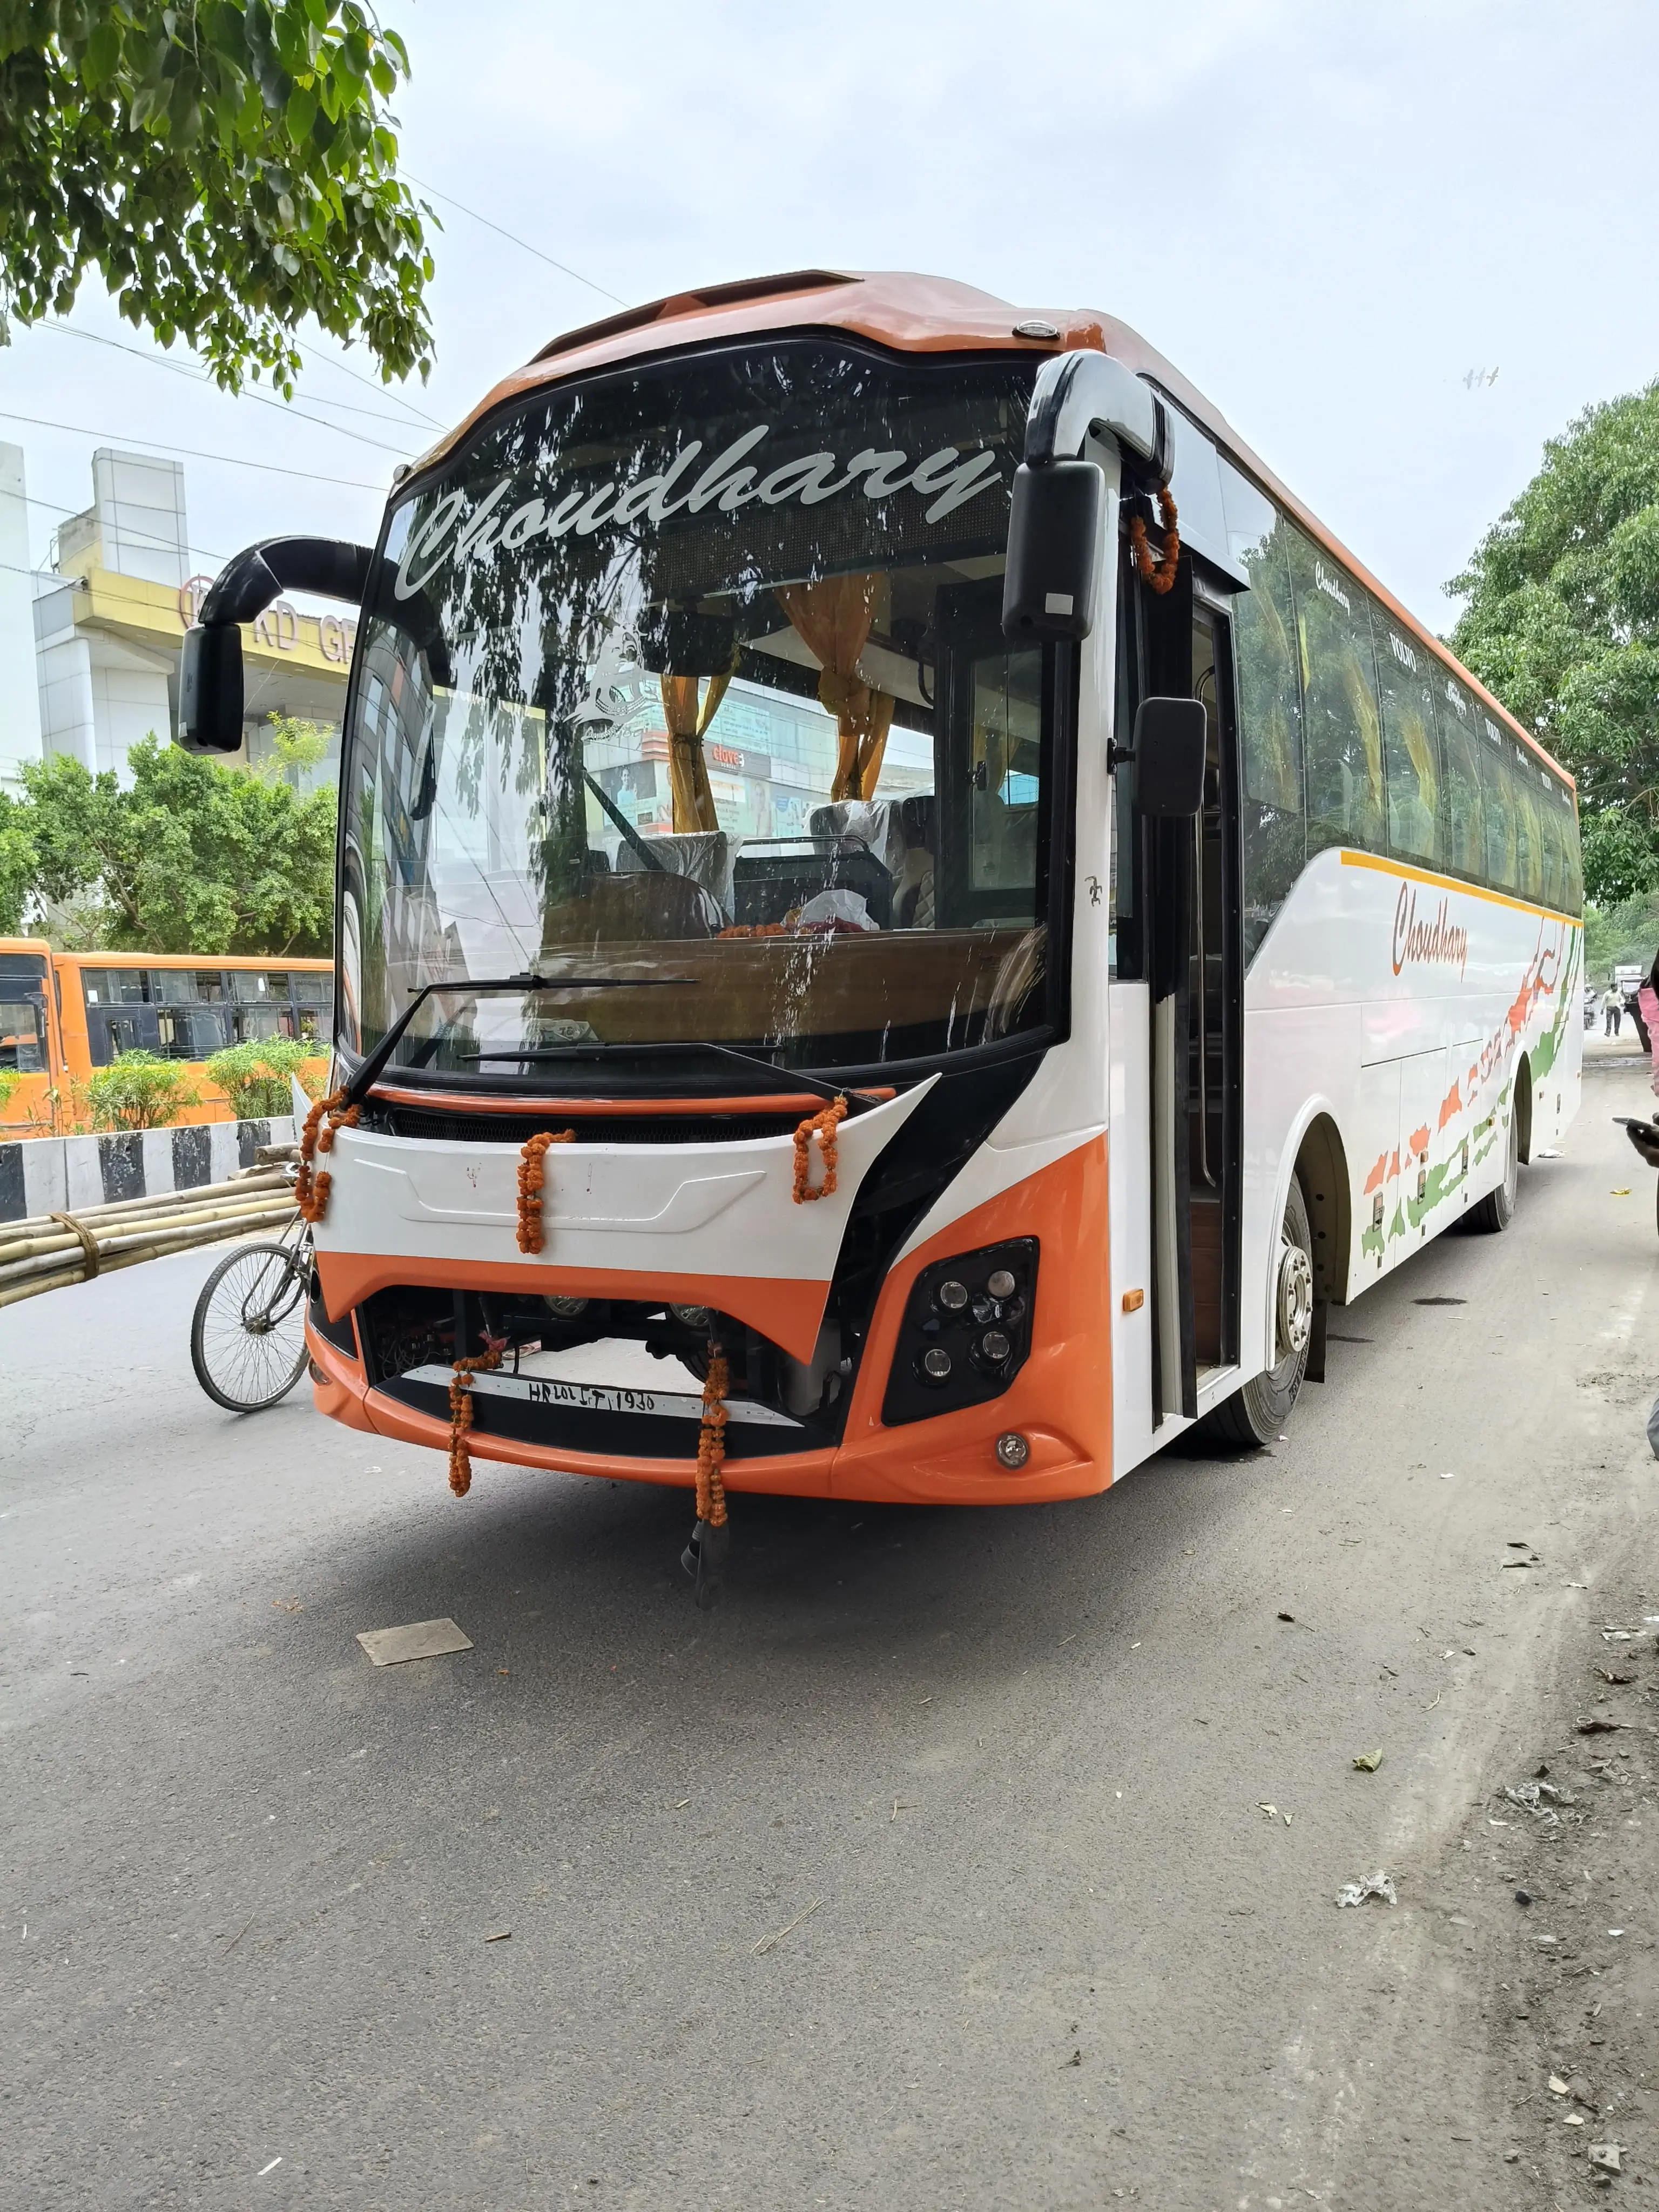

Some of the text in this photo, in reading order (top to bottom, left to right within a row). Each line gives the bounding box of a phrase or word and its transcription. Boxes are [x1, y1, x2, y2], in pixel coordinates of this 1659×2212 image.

[394, 424, 1002, 601] Choudhary
[1389, 631, 1417, 672] VOLVO
[712, 744, 740, 765] clove
[1392, 881, 1468, 983] Choudhary
